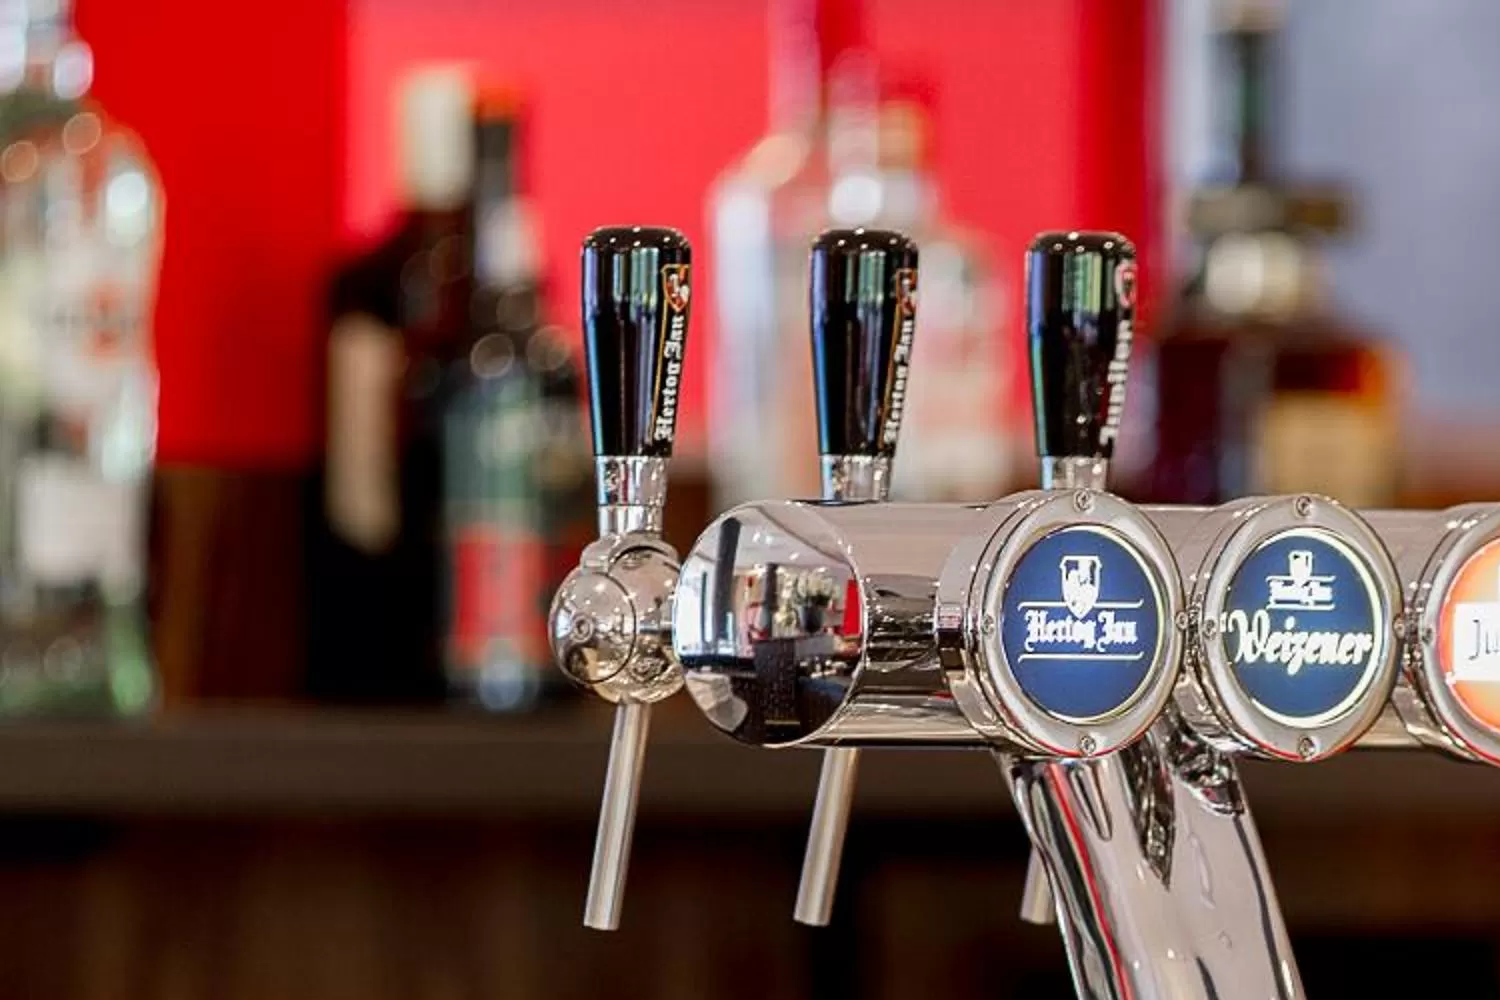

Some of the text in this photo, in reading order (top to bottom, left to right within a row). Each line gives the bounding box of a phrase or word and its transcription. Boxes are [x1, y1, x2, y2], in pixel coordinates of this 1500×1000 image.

[654, 314, 684, 442] Hertog Jan
[1024, 609, 1138, 652] Hertog Jan
